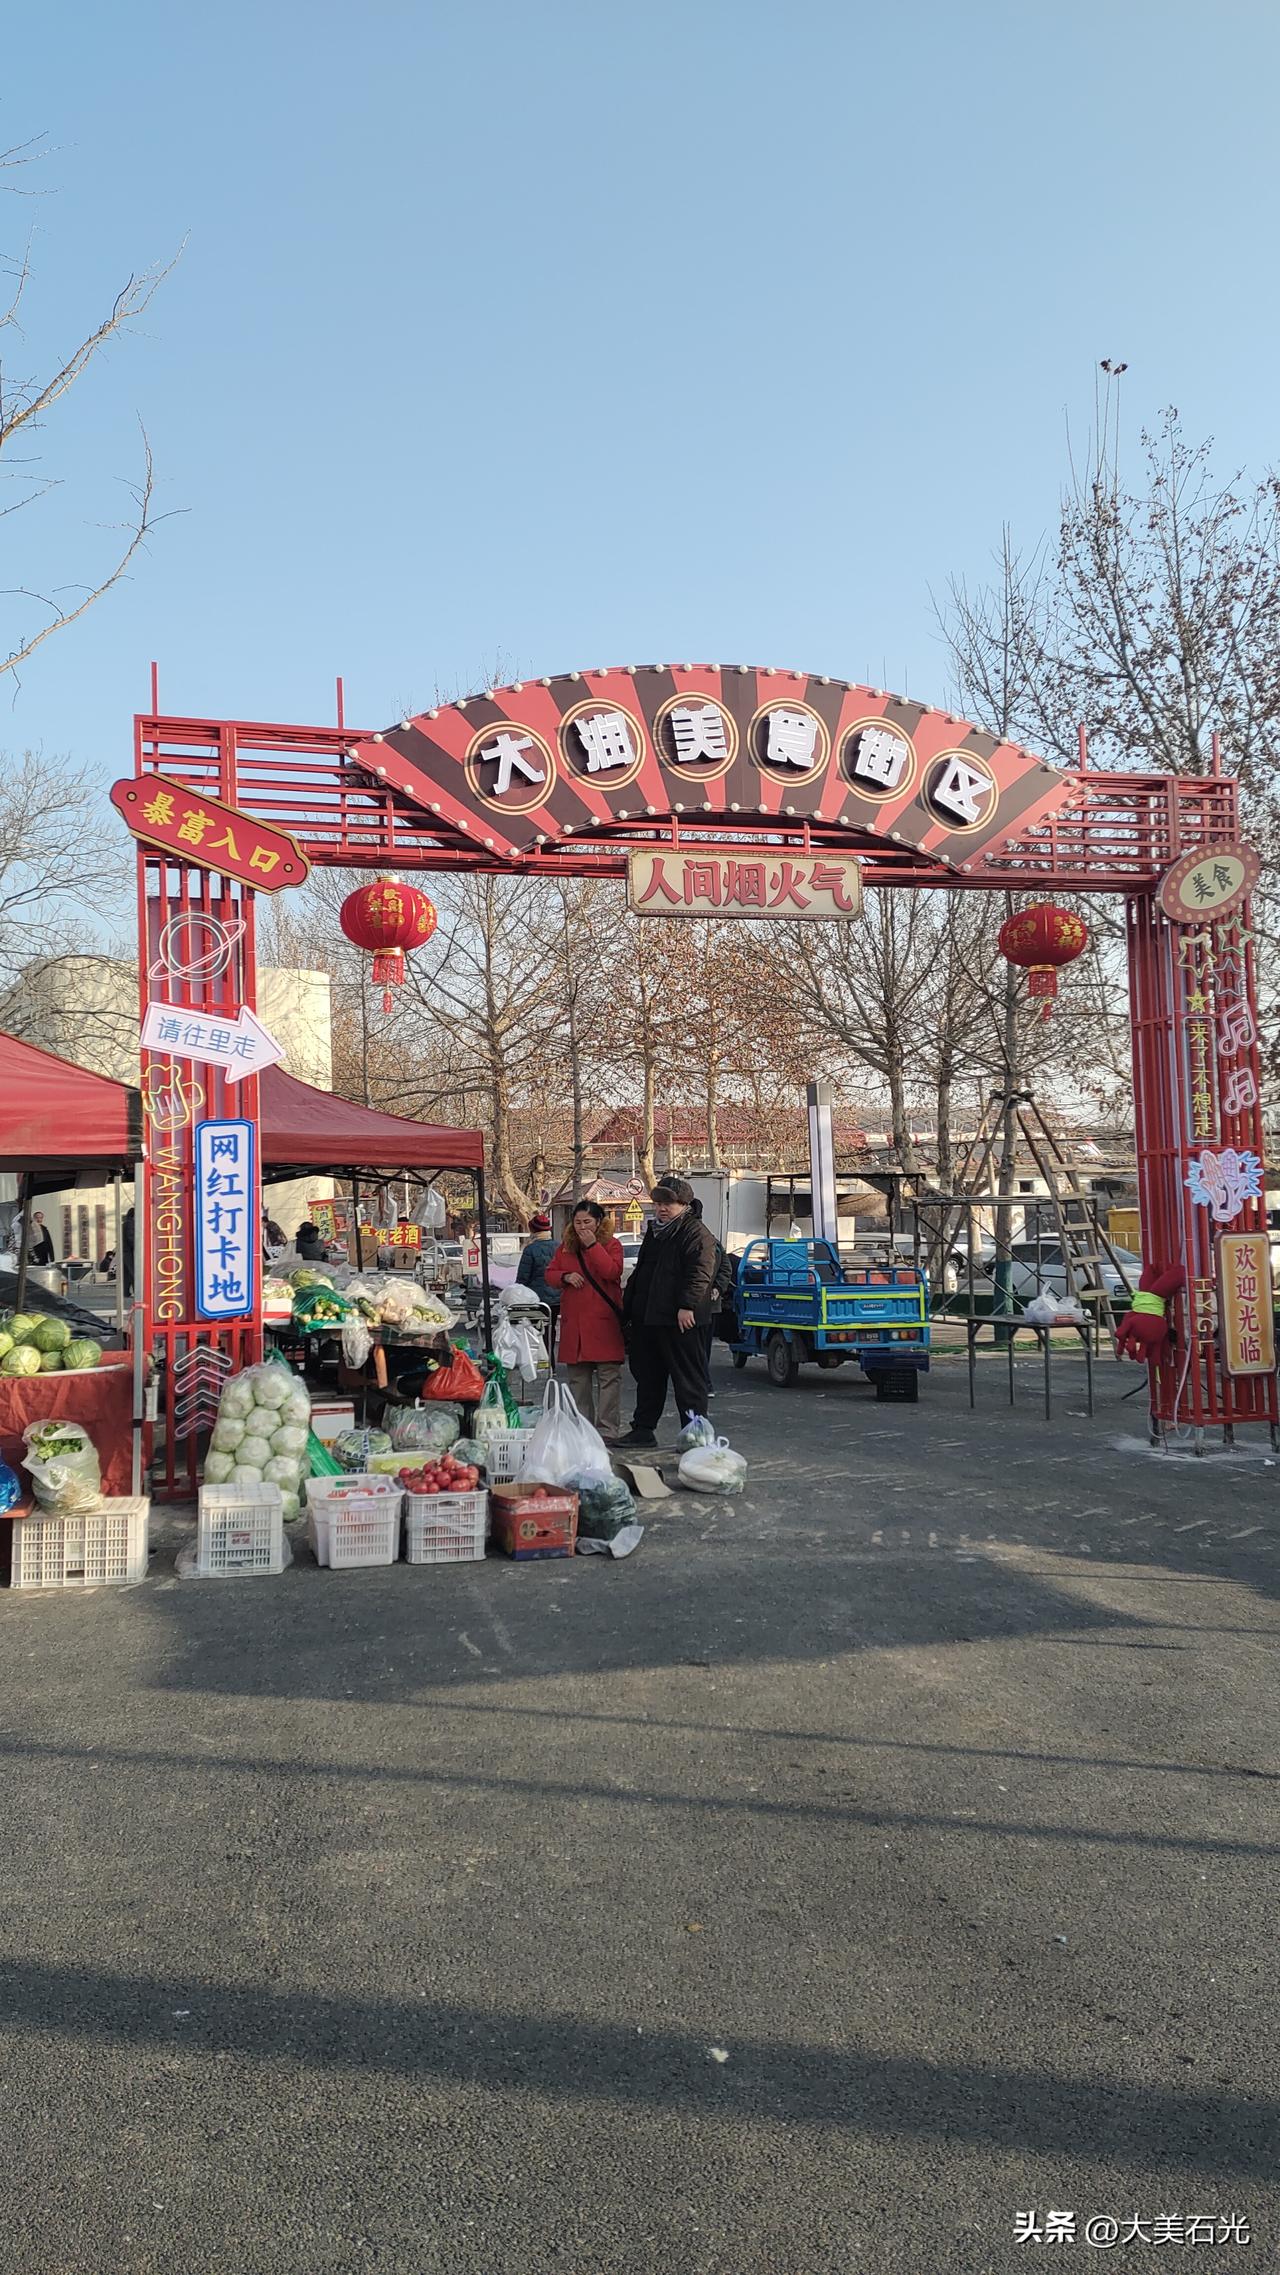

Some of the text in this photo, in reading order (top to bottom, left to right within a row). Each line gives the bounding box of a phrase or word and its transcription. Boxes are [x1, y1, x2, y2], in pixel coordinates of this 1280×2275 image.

[480, 705, 994, 823] 大润美食街区
[139, 791, 280, 873] 暴富入口
[638, 857, 854, 911] 人间烟火气
[1192, 863, 1234, 904] 美食
[157, 1016, 257, 1060] 请往里走
[1189, 1021, 1214, 1137] 来了不想走
[156, 1146, 183, 1320] WANGHONG
[206, 1133, 245, 1303] 网红打卡地
[1194, 1278, 1215, 1354] HYGL
[1234, 1243, 1262, 1364] 欢迎光临
